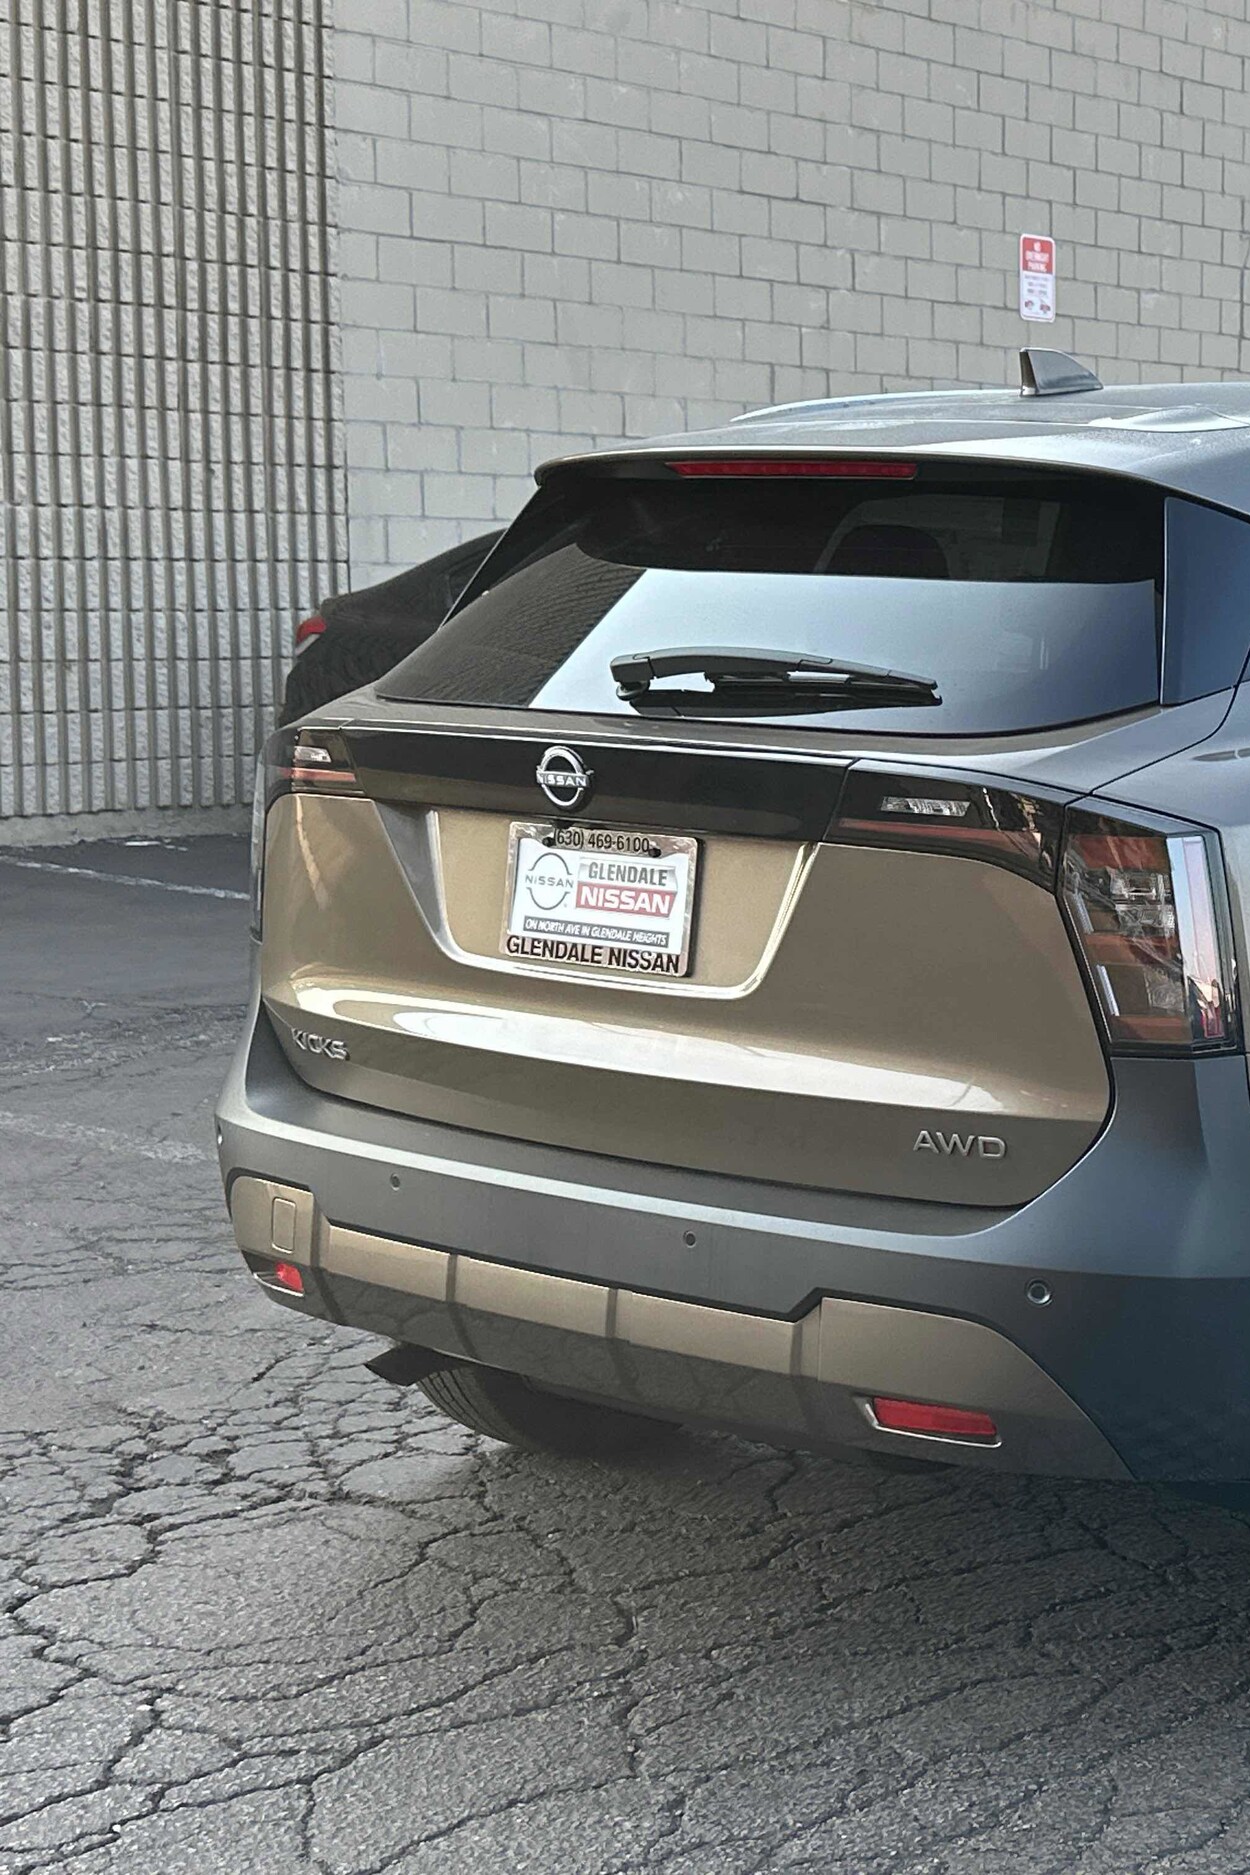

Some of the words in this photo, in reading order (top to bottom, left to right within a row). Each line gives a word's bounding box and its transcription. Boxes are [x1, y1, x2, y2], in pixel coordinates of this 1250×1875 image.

[537, 772, 587, 787] NISSAN
[554, 828, 585, 849] (630)
[588, 833, 650, 853] 469-6100
[525, 874, 574, 889] NISSAN
[588, 861, 668, 887] GLENDALE
[580, 886, 670, 914] NISSAN
[525, 918, 537, 930] ON
[537, 920, 564, 932] NORTH
[564, 923, 580, 935] AVE
[581, 925, 590, 937] IN
[591, 926, 633, 941] GLENDALE
[632, 931, 667, 945] HEIGHTS
[506, 935, 602, 964] GLENDALE
[607, 947, 680, 974] NISSAN
[291, 1028, 347, 1060] KICKS
[913, 1131, 1006, 1157] AWD
